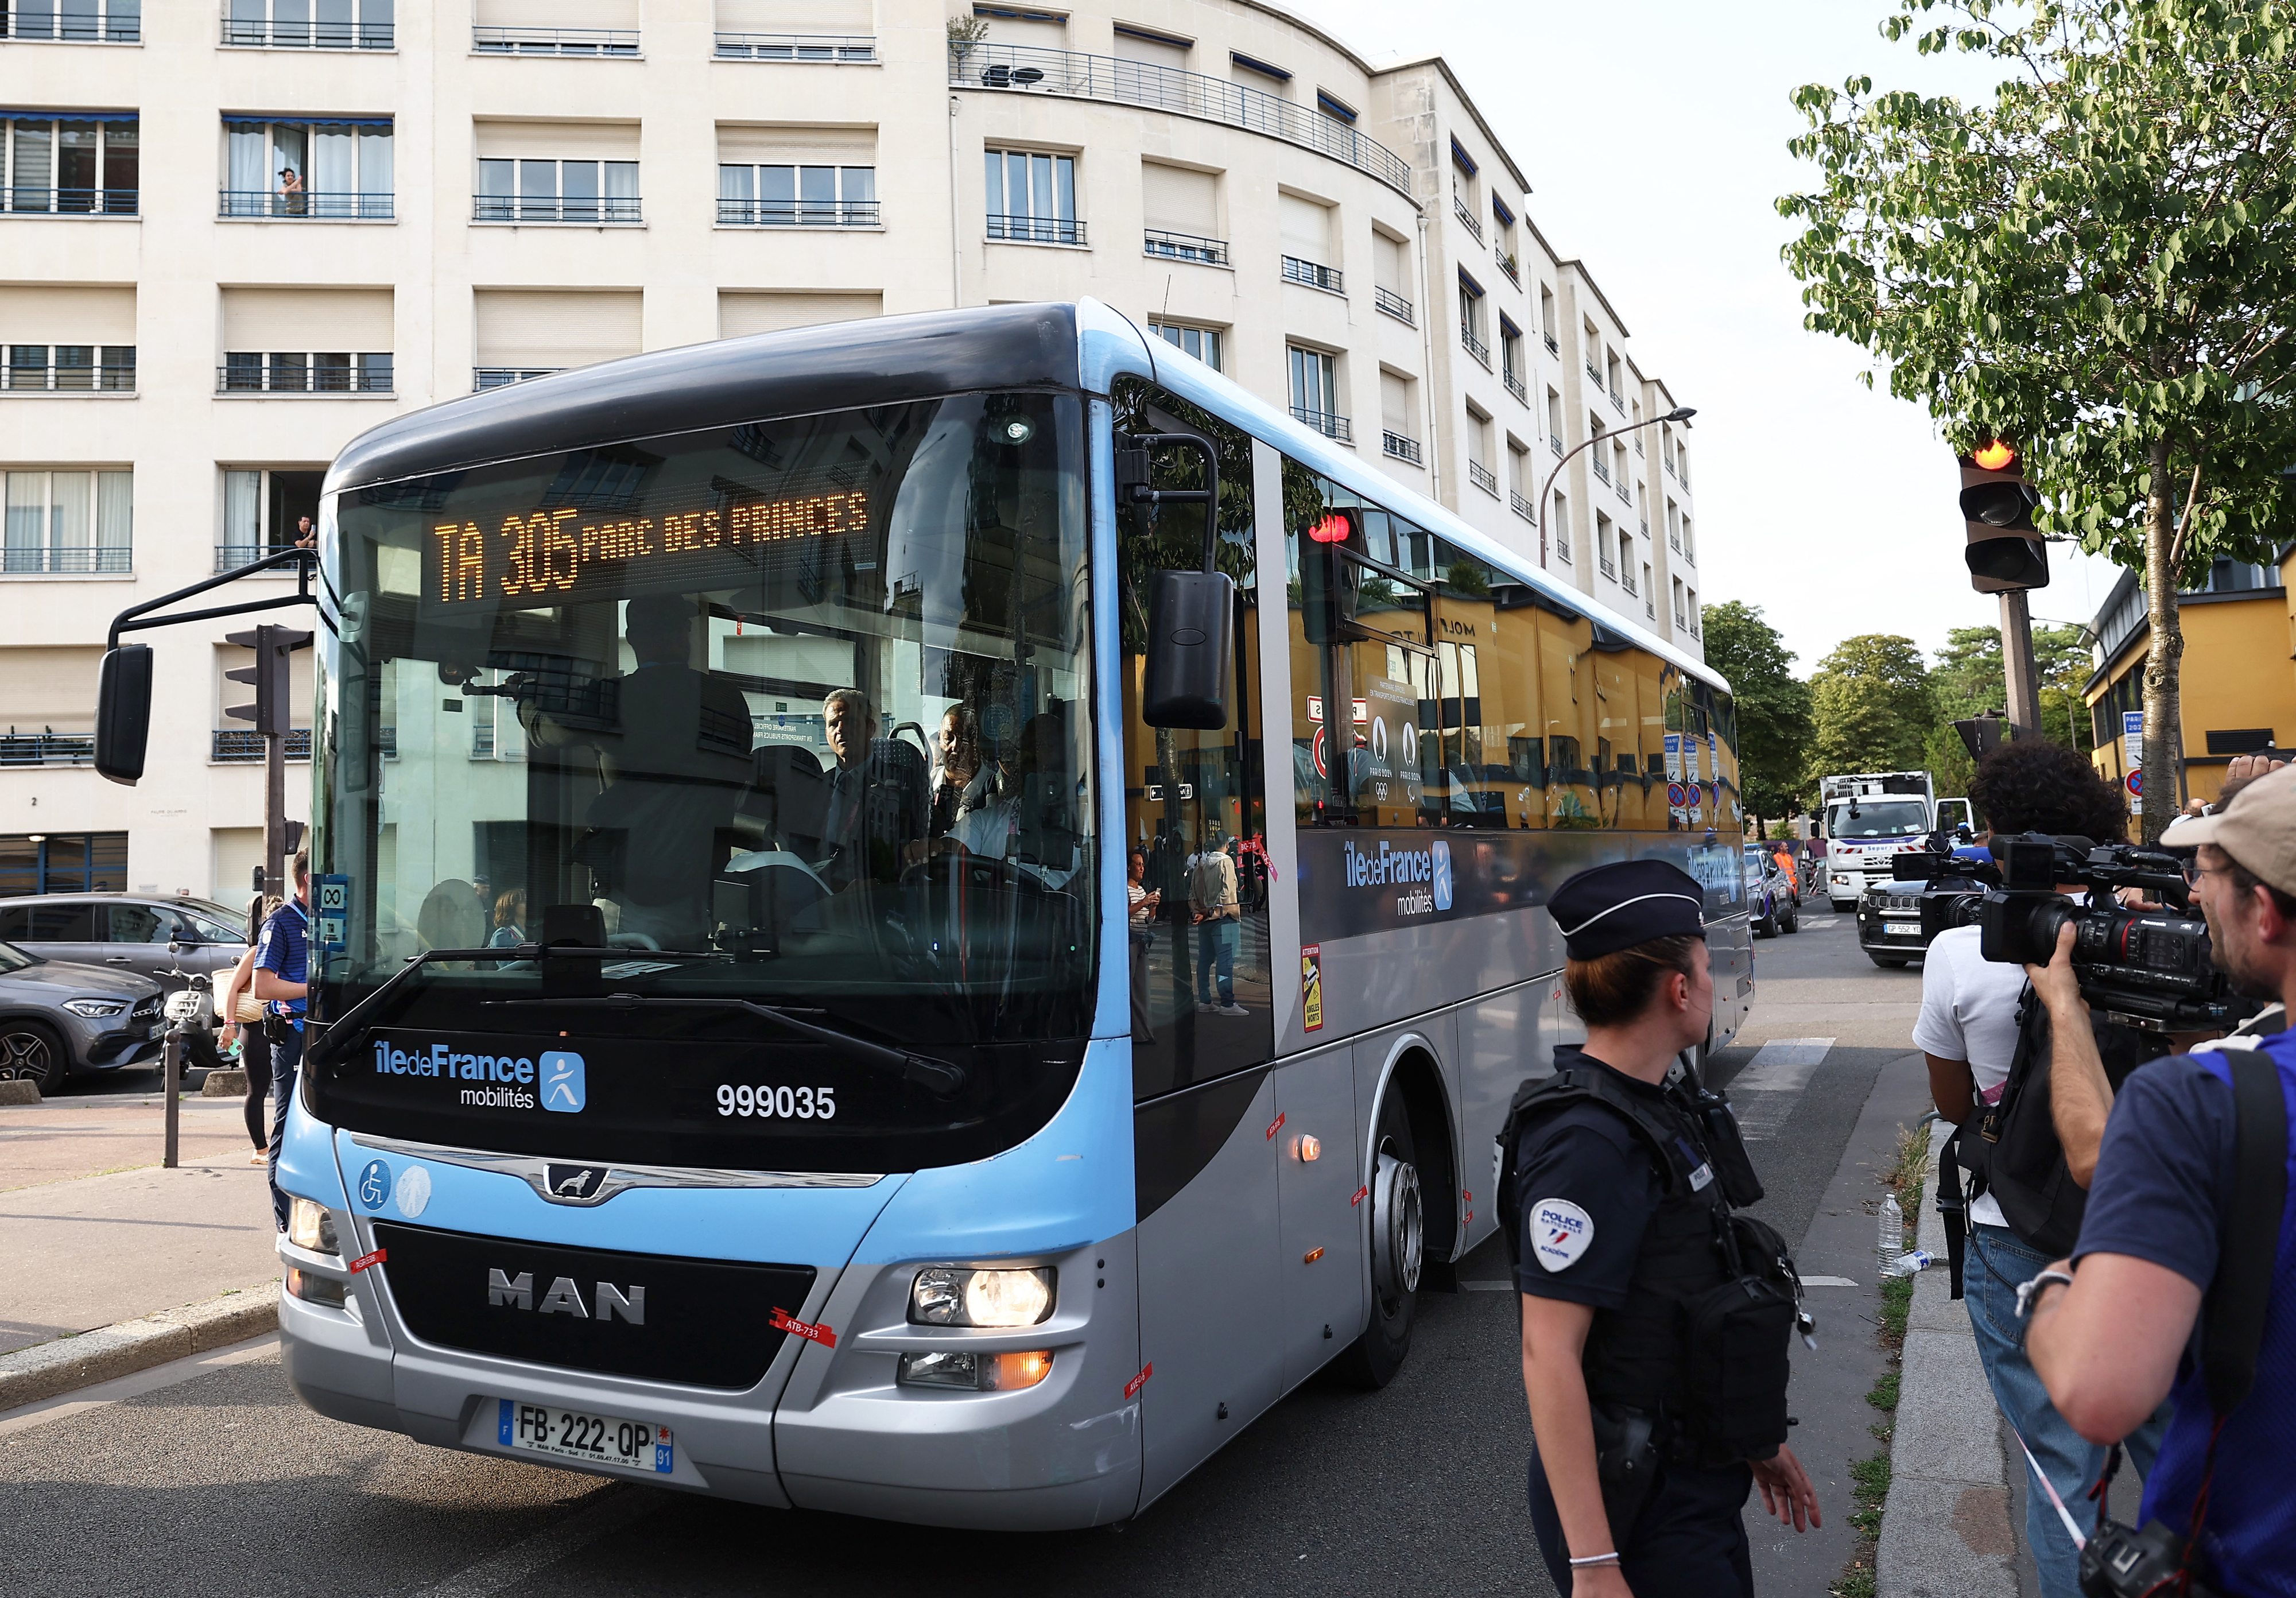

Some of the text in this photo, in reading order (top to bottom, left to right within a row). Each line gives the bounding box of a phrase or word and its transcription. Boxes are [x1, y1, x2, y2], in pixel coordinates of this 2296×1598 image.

[435, 491, 868, 602] TA 305 PARC DES PRINCES
[1382, 768, 1393, 778] 2024
[1411, 772, 1421, 781] 2024
[31, 797, 37, 806] 2
[1397, 887, 1433, 916] mobilités
[2140, 919, 2167, 927] Panasonic
[1302, 947, 1319, 956] ATTENTION
[1306, 1003, 1320, 1014] ANGLES
[1307, 1012, 1320, 1023] MORTS
[460, 1087, 534, 1109] mobilités
[716, 1084, 836, 1119] 999035
[1541, 1217, 1582, 1235] NATIONALE
[1542, 1209, 1583, 1229] POLICE
[488, 1267, 646, 1325] MAN
[785, 1320, 819, 1339] ATB-733
[502, 1425, 509, 1436] F
[657, 1449, 670, 1467] 91
